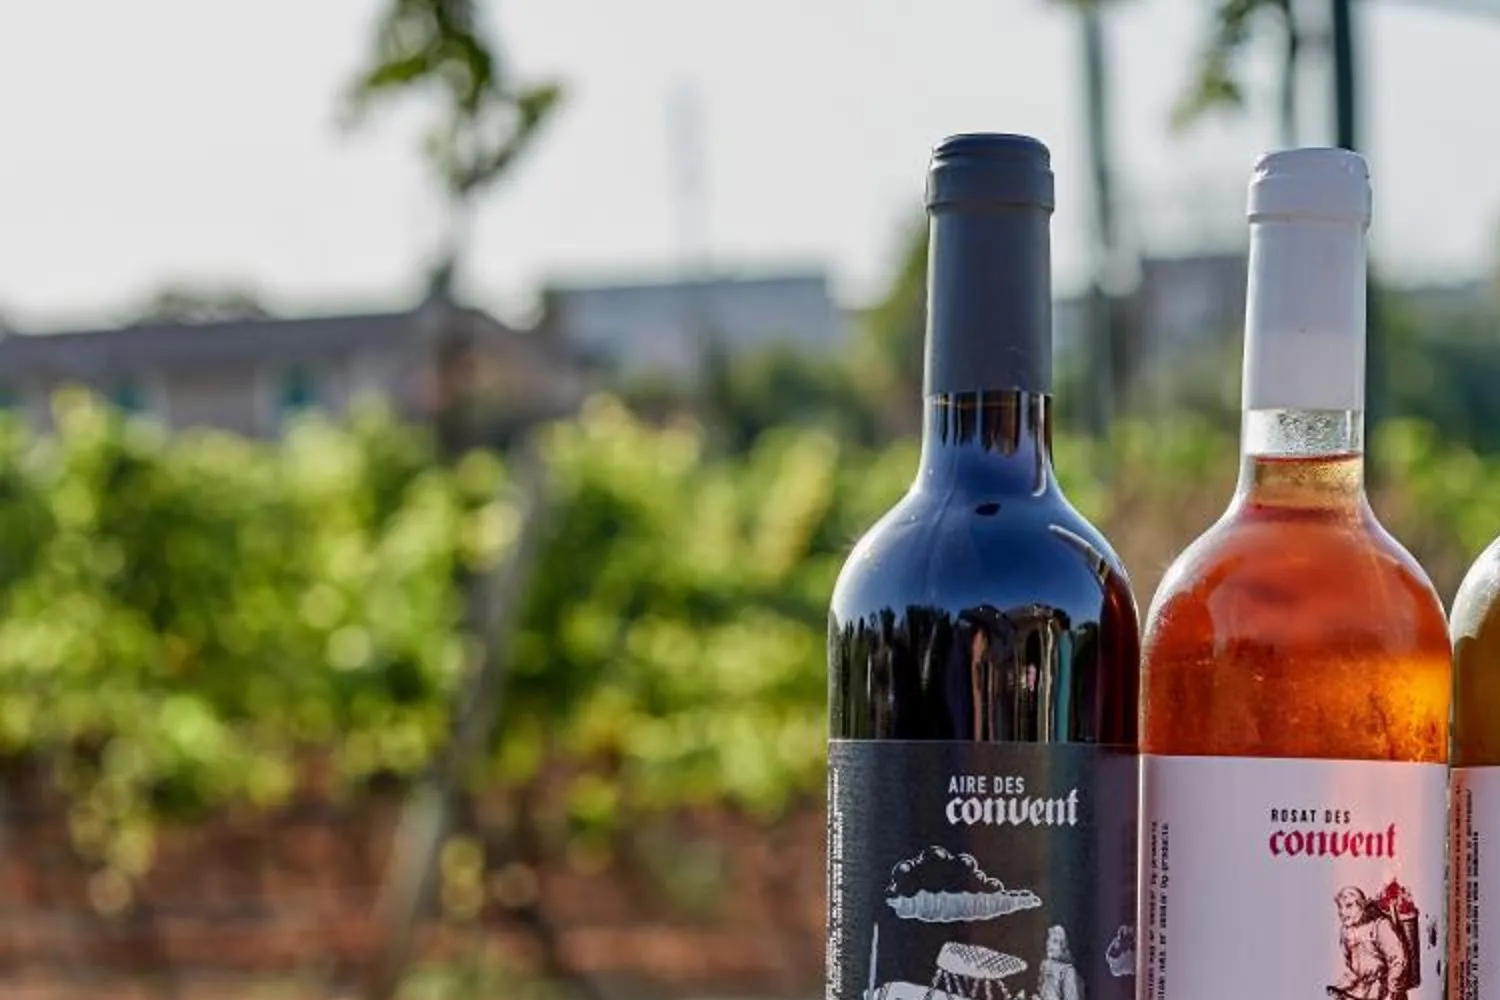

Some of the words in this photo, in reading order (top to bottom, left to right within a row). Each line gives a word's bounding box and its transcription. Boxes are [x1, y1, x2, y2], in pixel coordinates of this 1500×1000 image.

[948, 776, 986, 793] AIRE
[994, 776, 1025, 793] DES
[945, 788, 1078, 826] convent
[1271, 808, 1316, 822] ROSAT
[1325, 809, 1350, 824] DES
[1269, 823, 1395, 858] convent
